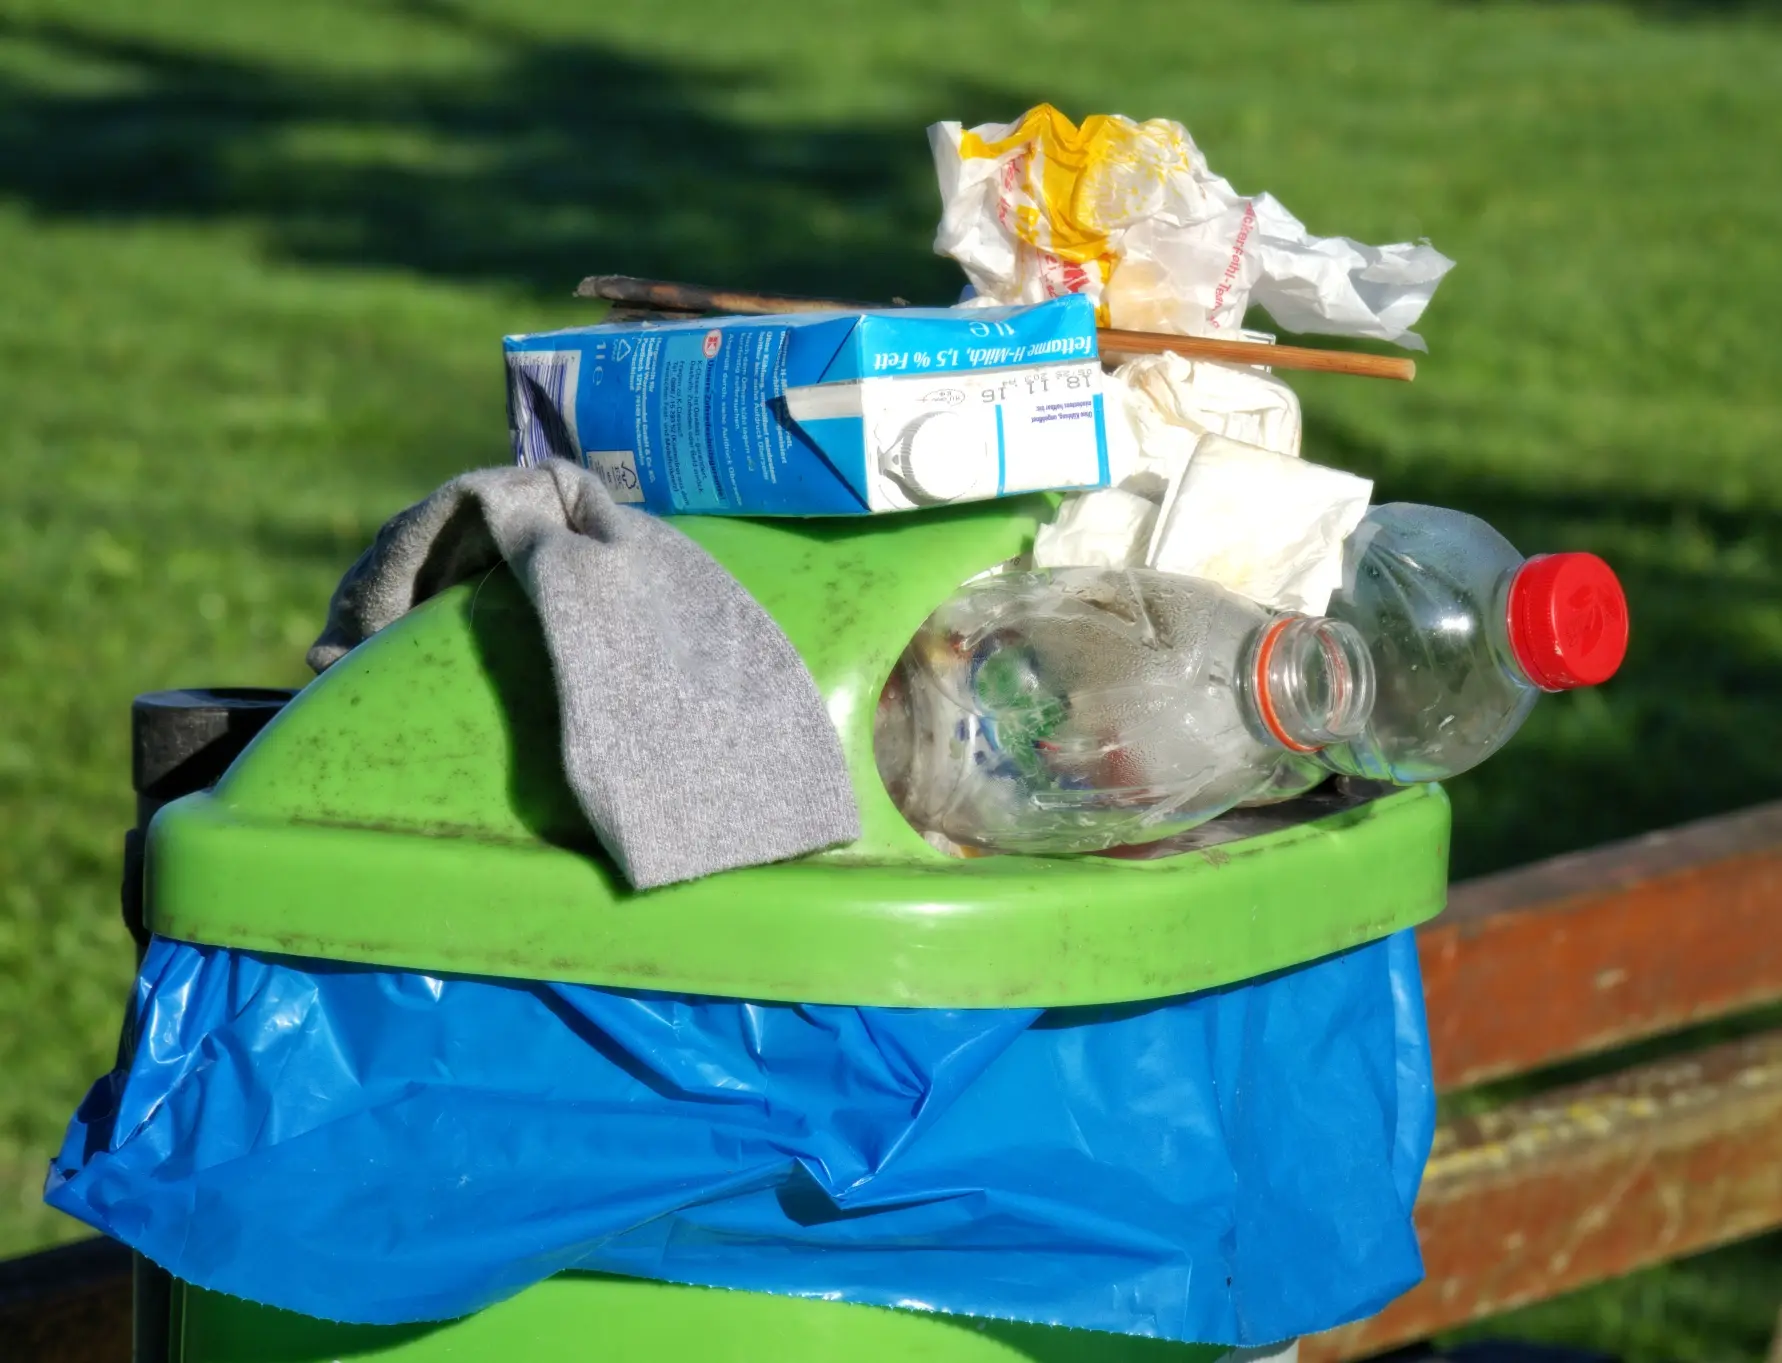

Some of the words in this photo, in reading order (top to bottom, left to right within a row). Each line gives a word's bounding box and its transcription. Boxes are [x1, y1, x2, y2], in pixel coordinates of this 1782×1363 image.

[1028, 335, 1091, 359] fettarme
[873, 352, 908, 370] Fett
[914, 352, 931, 368] %
[936, 349, 959, 367] 1,5
[967, 346, 1026, 367] H-Milch,
